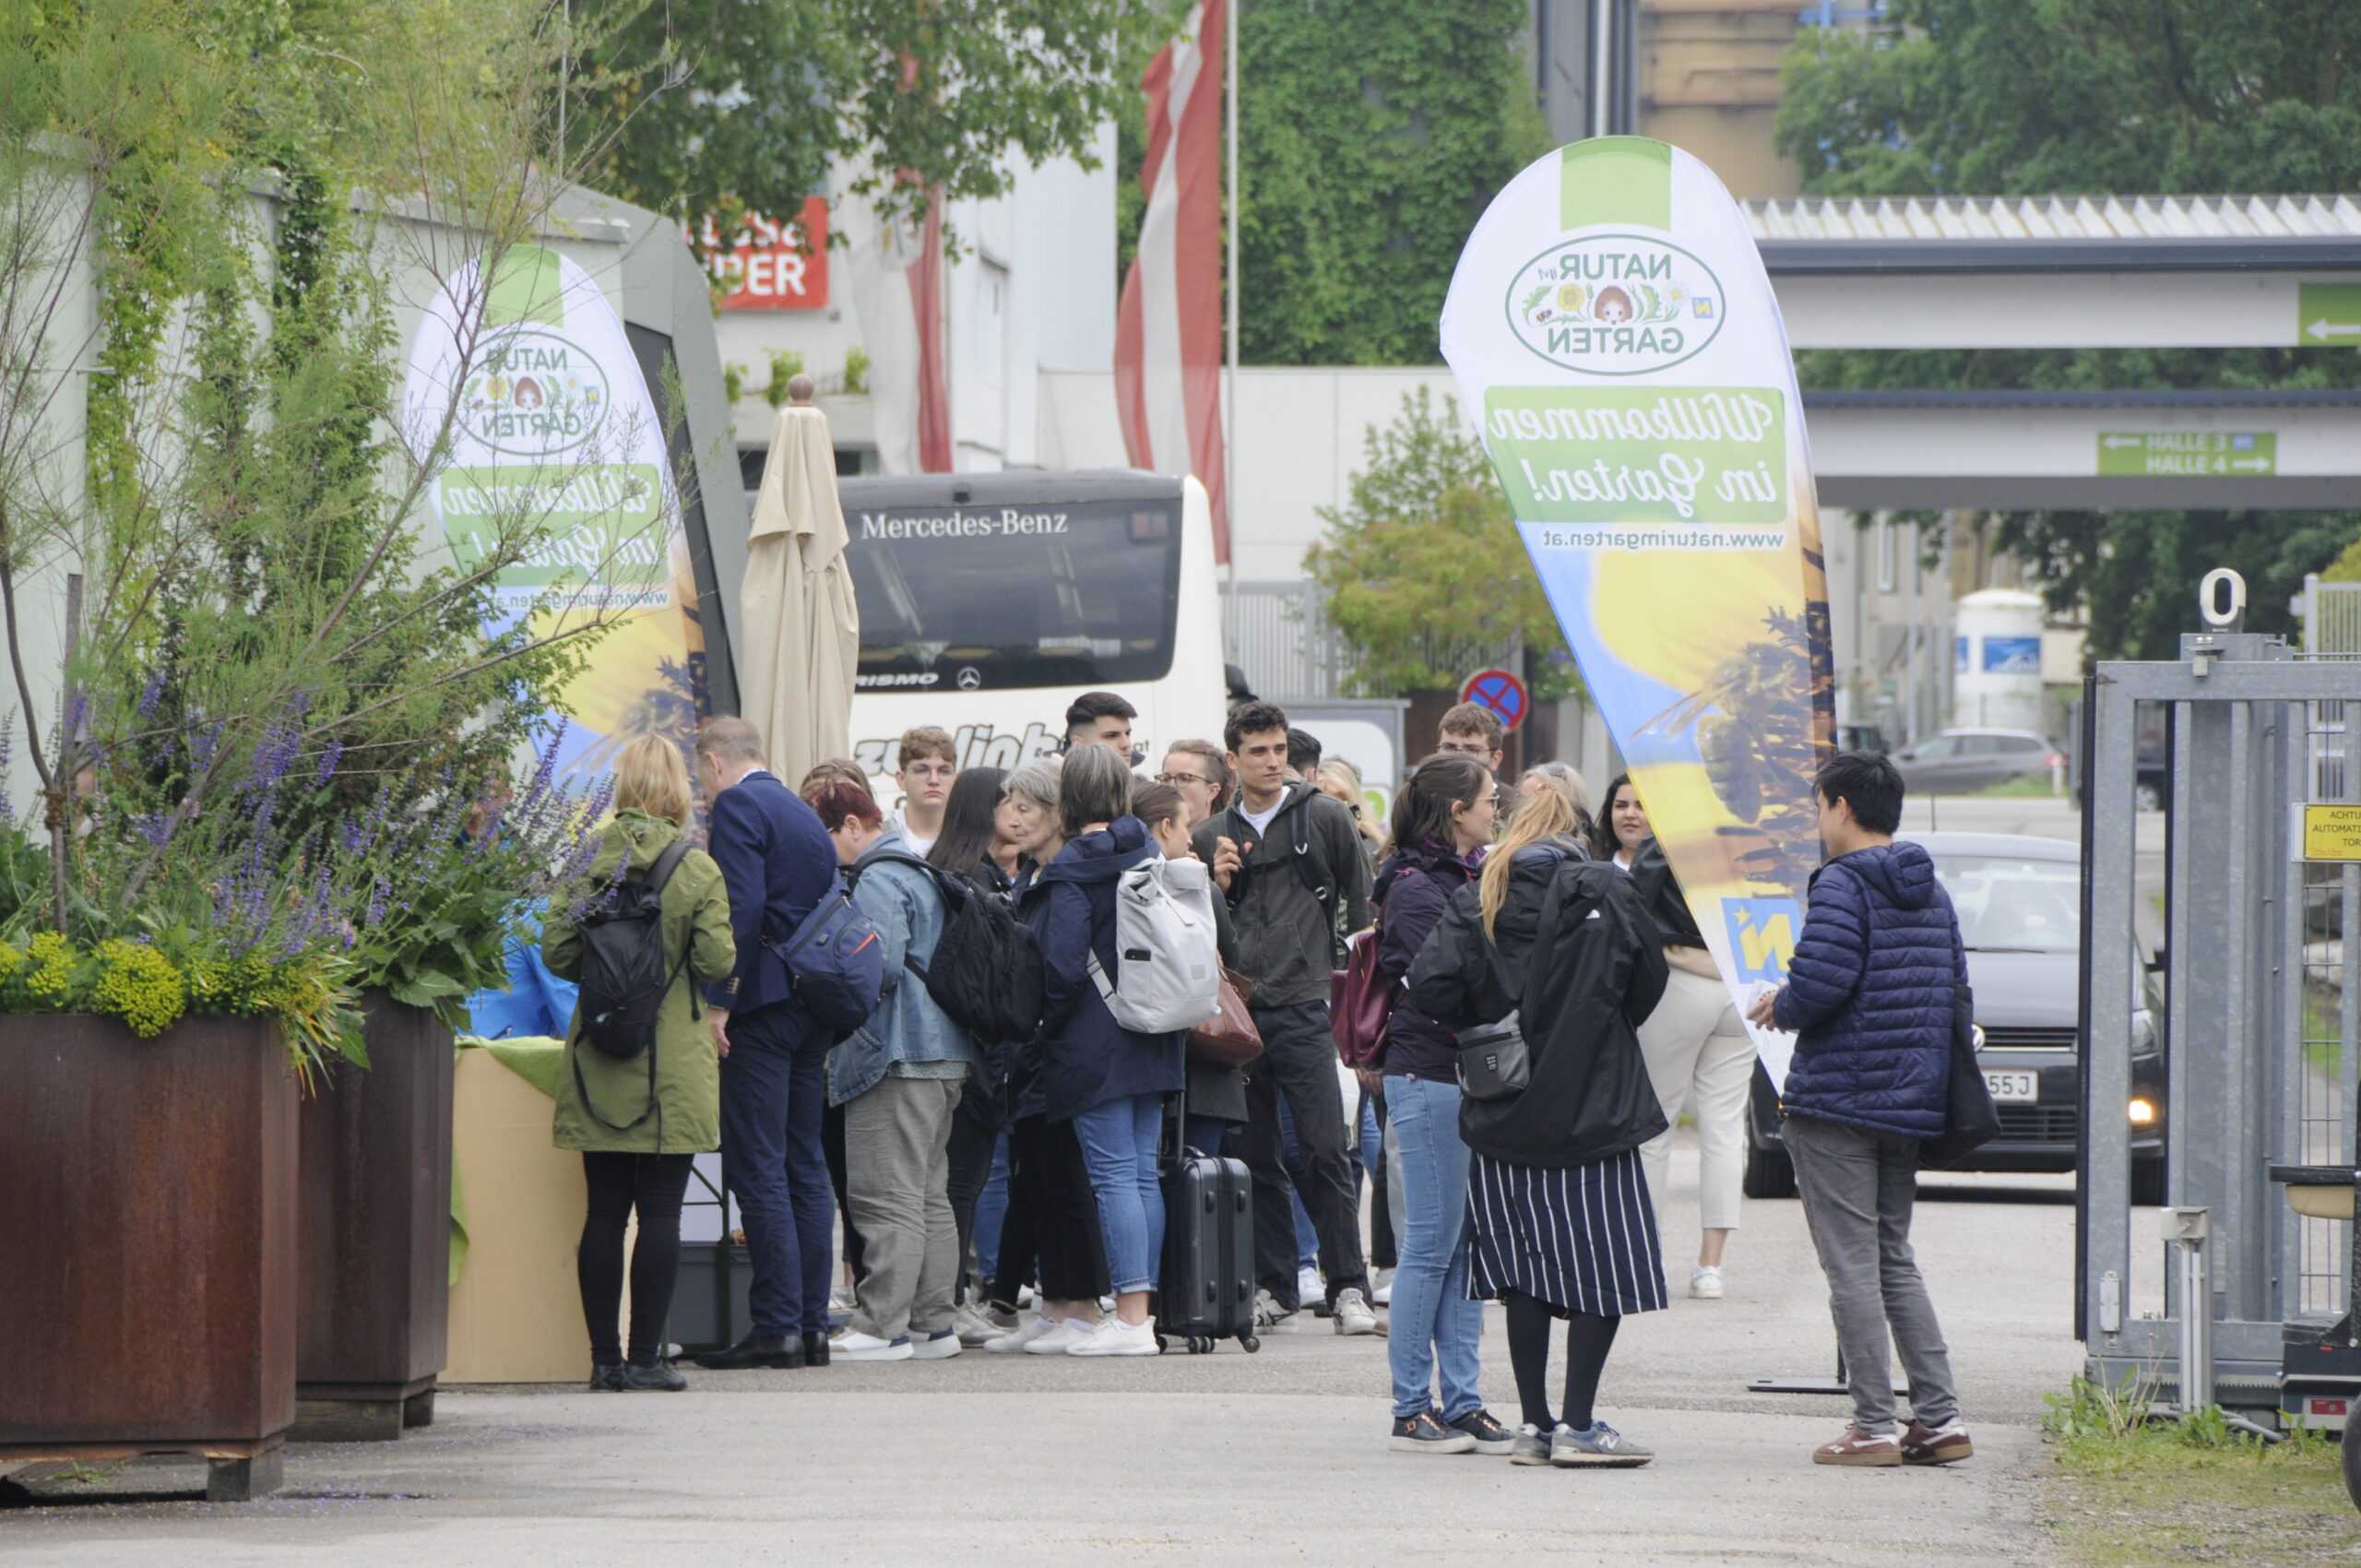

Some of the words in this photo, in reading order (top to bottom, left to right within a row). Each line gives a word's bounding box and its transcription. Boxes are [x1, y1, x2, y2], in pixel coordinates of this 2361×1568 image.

[2146, 434, 2207, 452] HALLE
[2146, 456, 2207, 473] HALLE
[860, 510, 1068, 540] Mercedes-Benz
